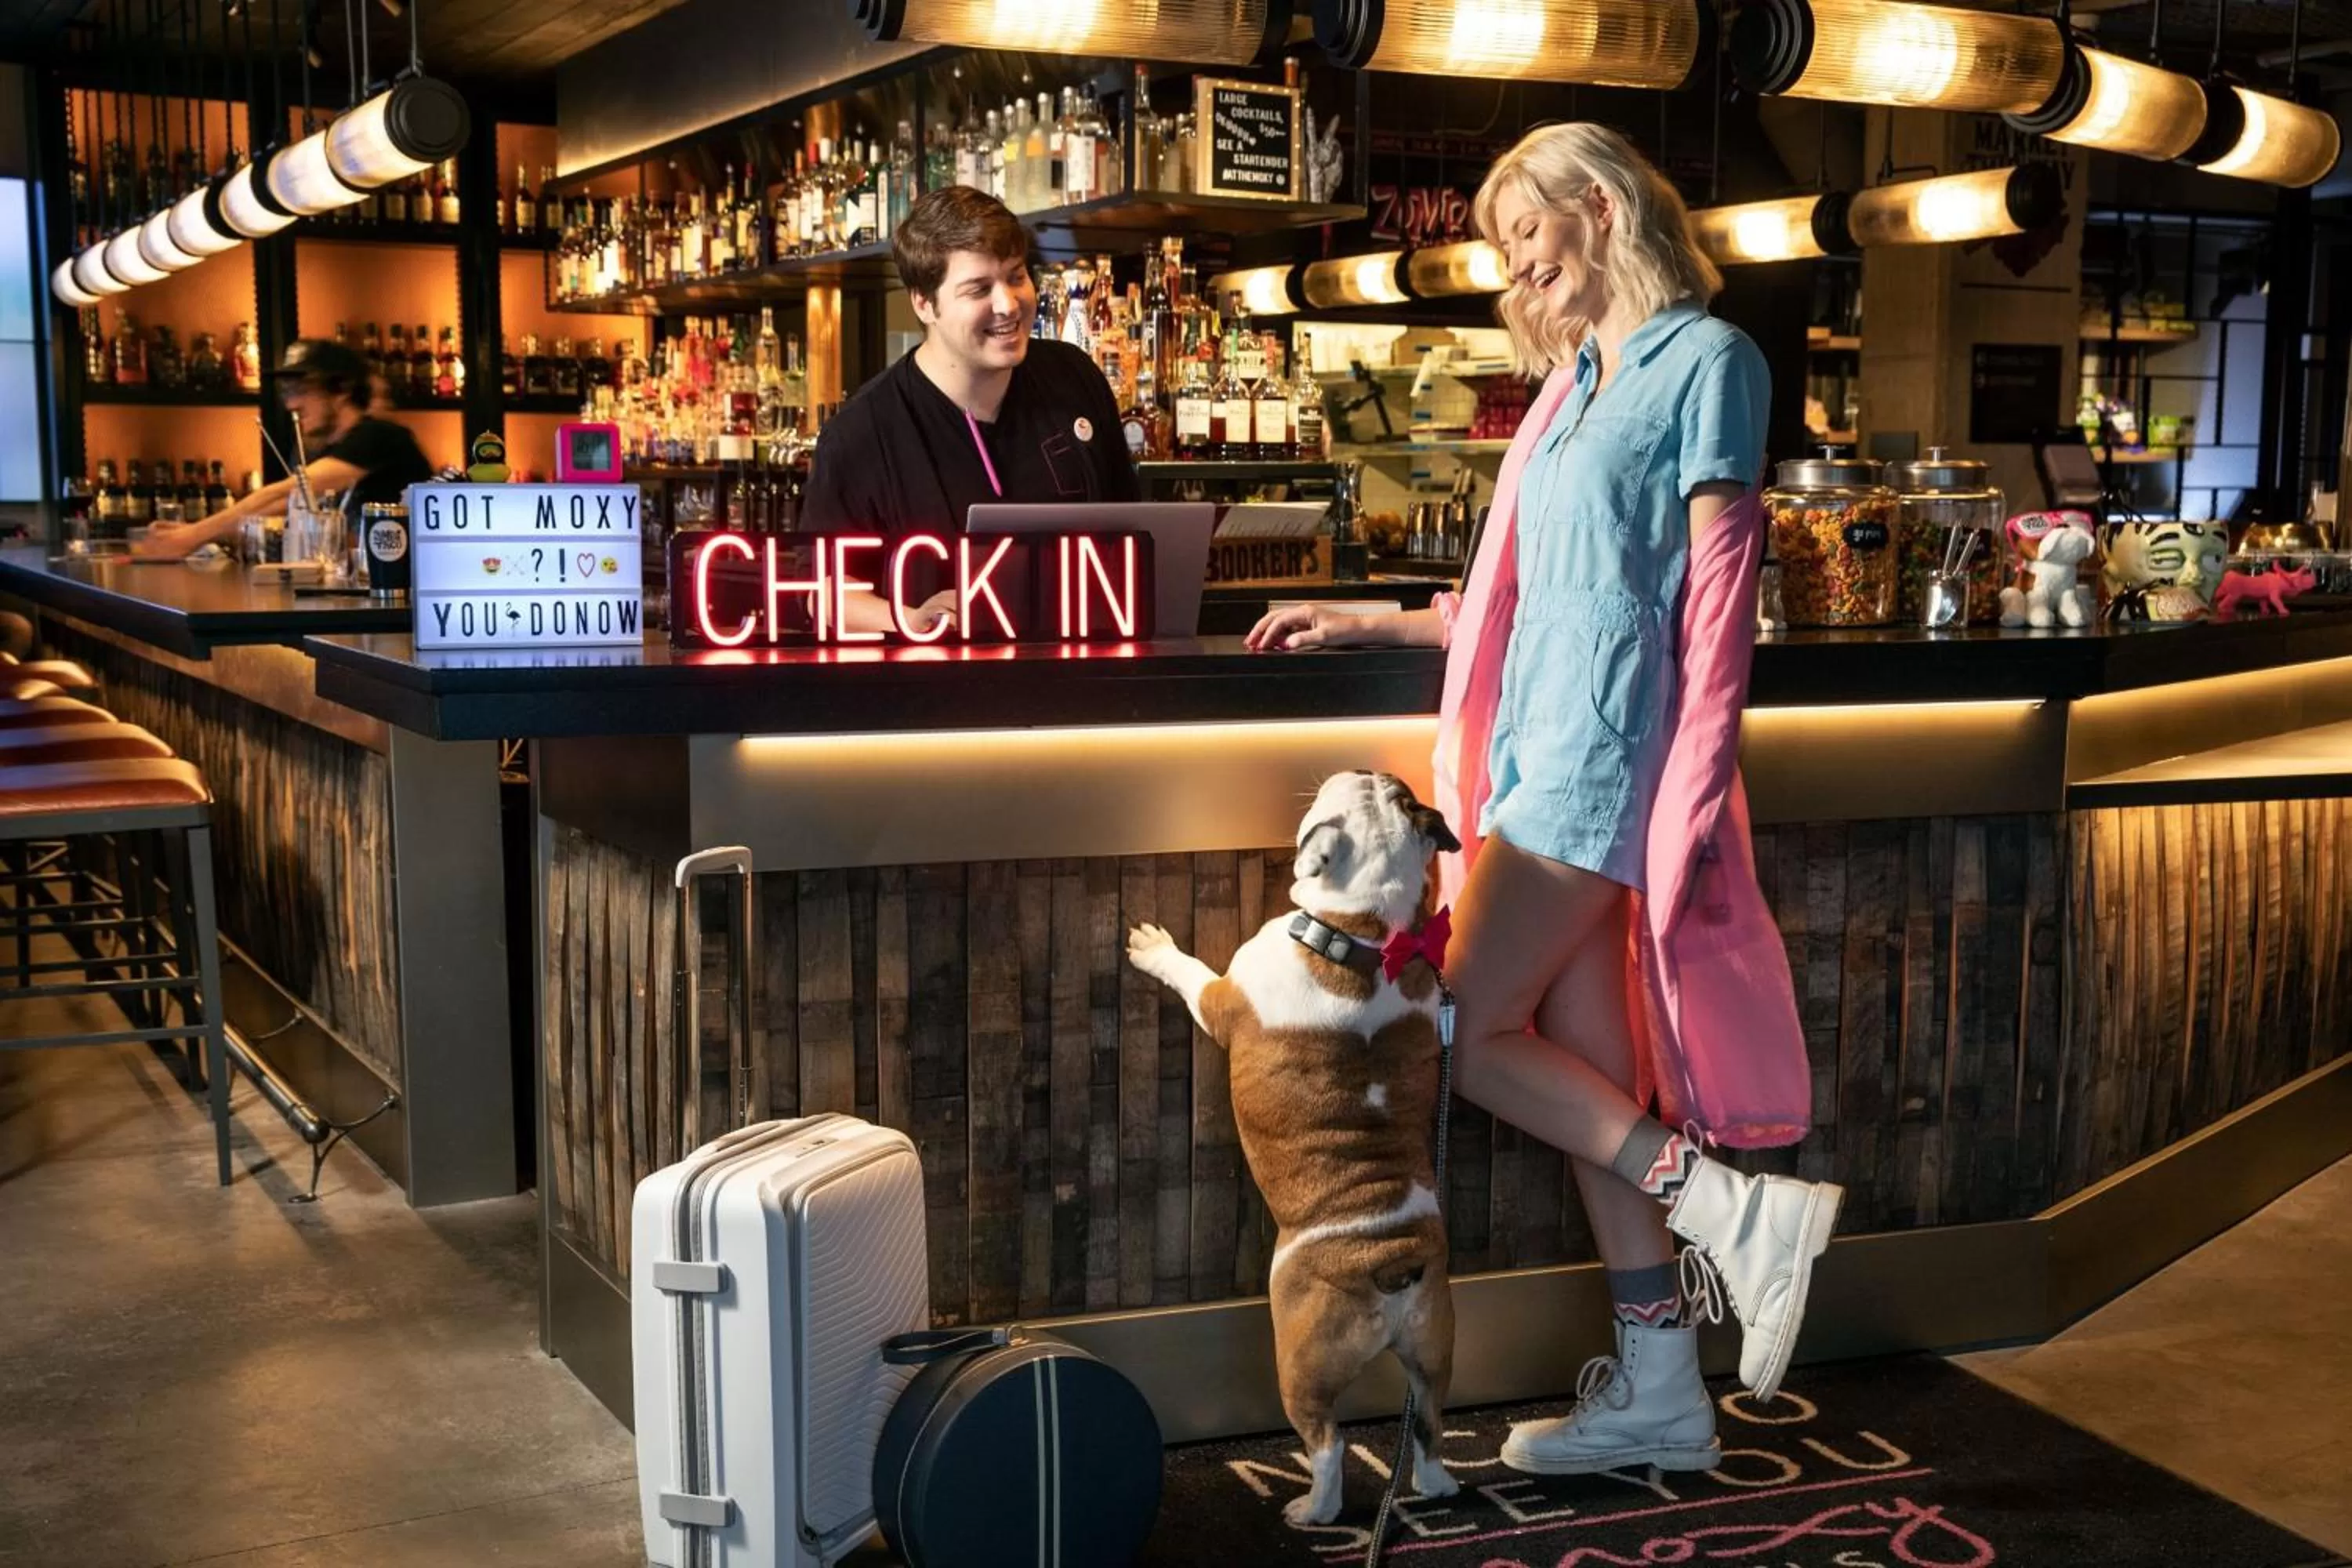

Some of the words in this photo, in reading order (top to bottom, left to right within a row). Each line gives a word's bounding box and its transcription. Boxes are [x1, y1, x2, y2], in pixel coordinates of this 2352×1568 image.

[424, 495, 494, 530] GOT
[535, 495, 637, 529] MOXY
[433, 602, 497, 637] YOU
[695, 533, 1018, 647] CHECK
[1060, 535, 1136, 639] IN
[1286, 1478, 1576, 1553] SEE
[1598, 1430, 1911, 1501] YOU
